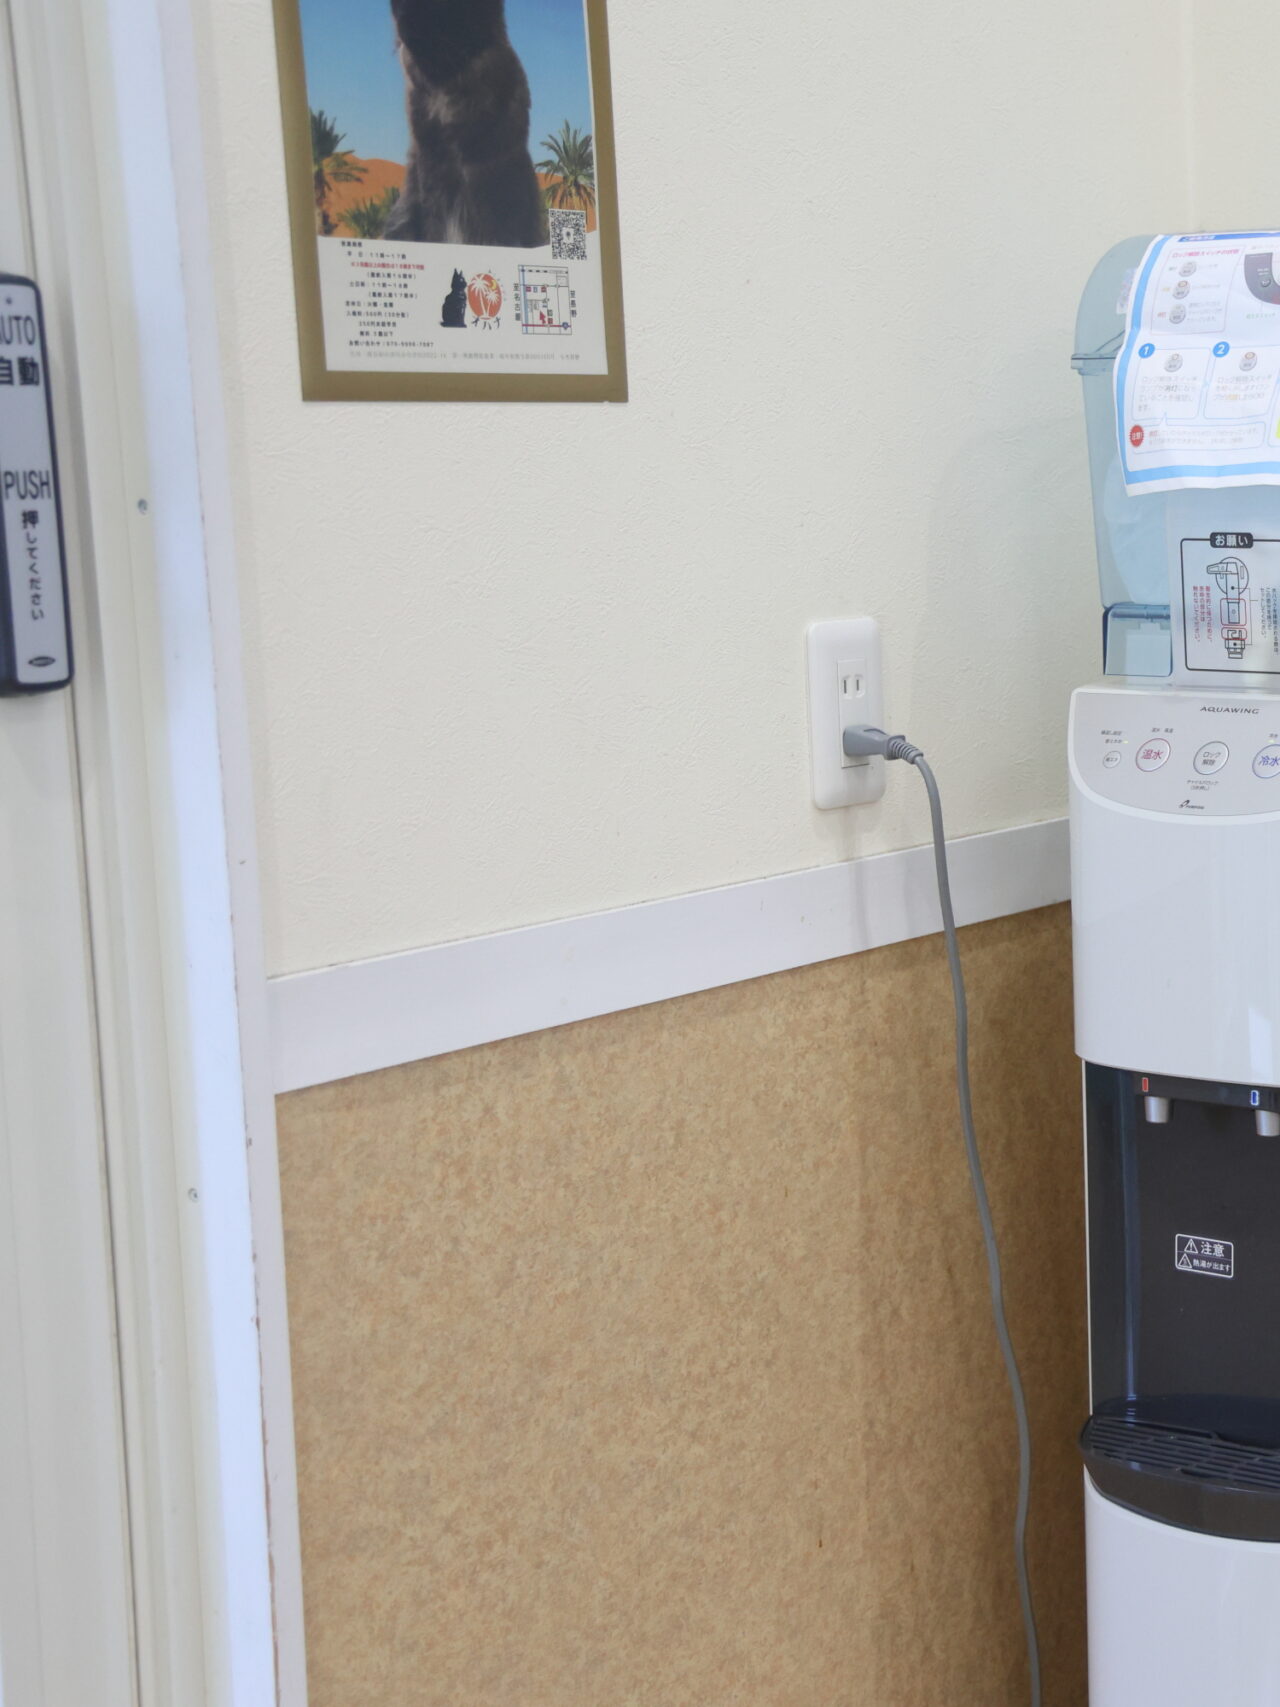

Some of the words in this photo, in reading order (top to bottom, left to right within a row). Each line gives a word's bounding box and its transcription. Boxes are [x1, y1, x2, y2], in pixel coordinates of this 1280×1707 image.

[0, 315, 36, 346] UTO
[1216, 344, 1226, 354] 2
[0, 356, 39, 386] 自動
[3, 469, 52, 501] PUSH
[1215, 534, 1249, 547] お願い
[22, 510, 45, 621] 押してください
[1200, 706, 1260, 715] AQUAWING
[1141, 748, 1163, 760] 温水
[1259, 755, 1280, 767] 冷水
[1200, 1241, 1225, 1257] 注意
